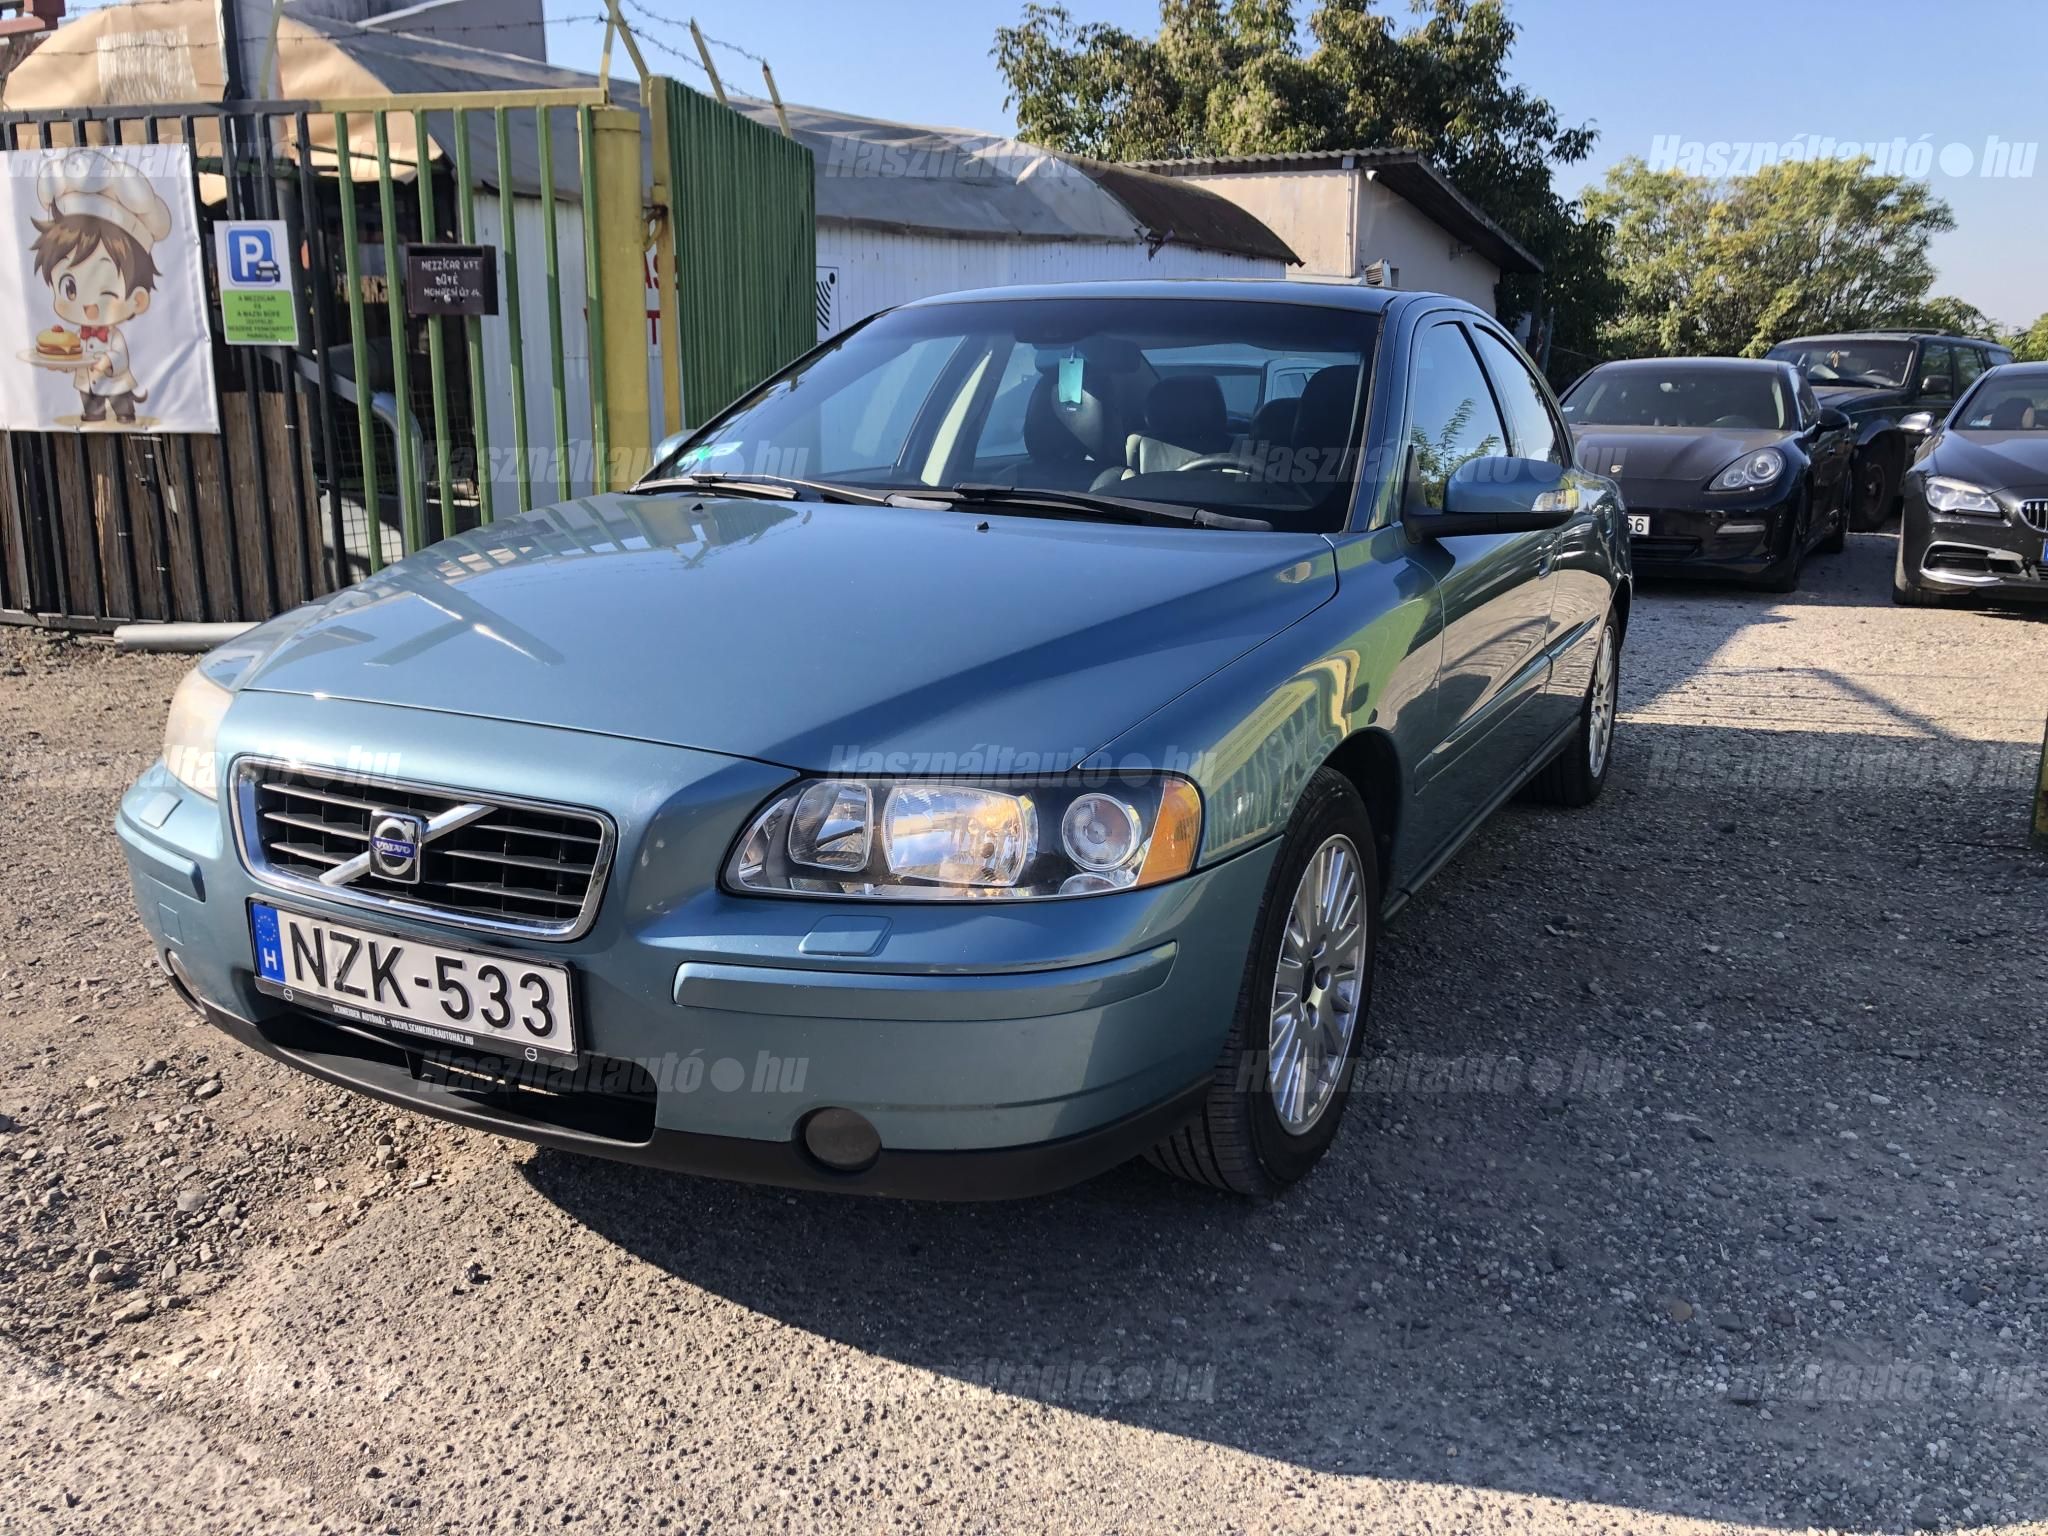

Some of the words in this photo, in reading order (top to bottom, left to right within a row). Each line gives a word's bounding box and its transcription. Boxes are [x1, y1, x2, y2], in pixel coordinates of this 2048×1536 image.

[239, 235, 264, 278] P
[375, 840, 411, 854] VOLVO
[262, 948, 278, 972] H
[288, 920, 554, 1038] NZK-533
[332, 1003, 361, 1020] SCHNEIDER
